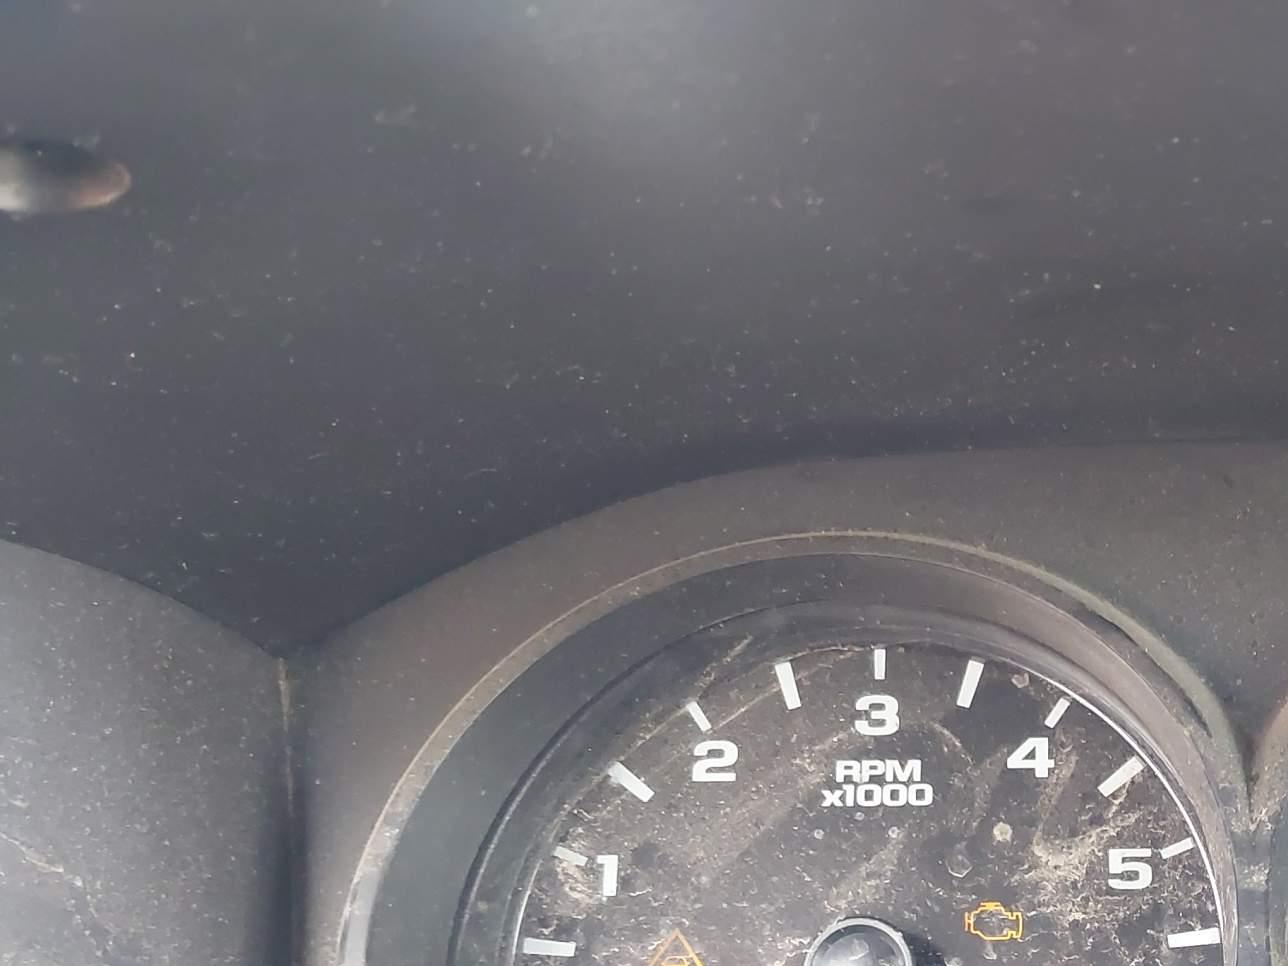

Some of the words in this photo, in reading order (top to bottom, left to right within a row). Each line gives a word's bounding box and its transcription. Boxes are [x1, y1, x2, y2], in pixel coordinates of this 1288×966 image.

[855, 695, 900, 736] 3
[691, 740, 740, 783] 2
[835, 760, 921, 783] RPM
[1006, 737, 1055, 779] 4
[821, 784, 934, 808] x1000
[595, 855, 618, 897] 1
[1107, 848, 1153, 890] 5
